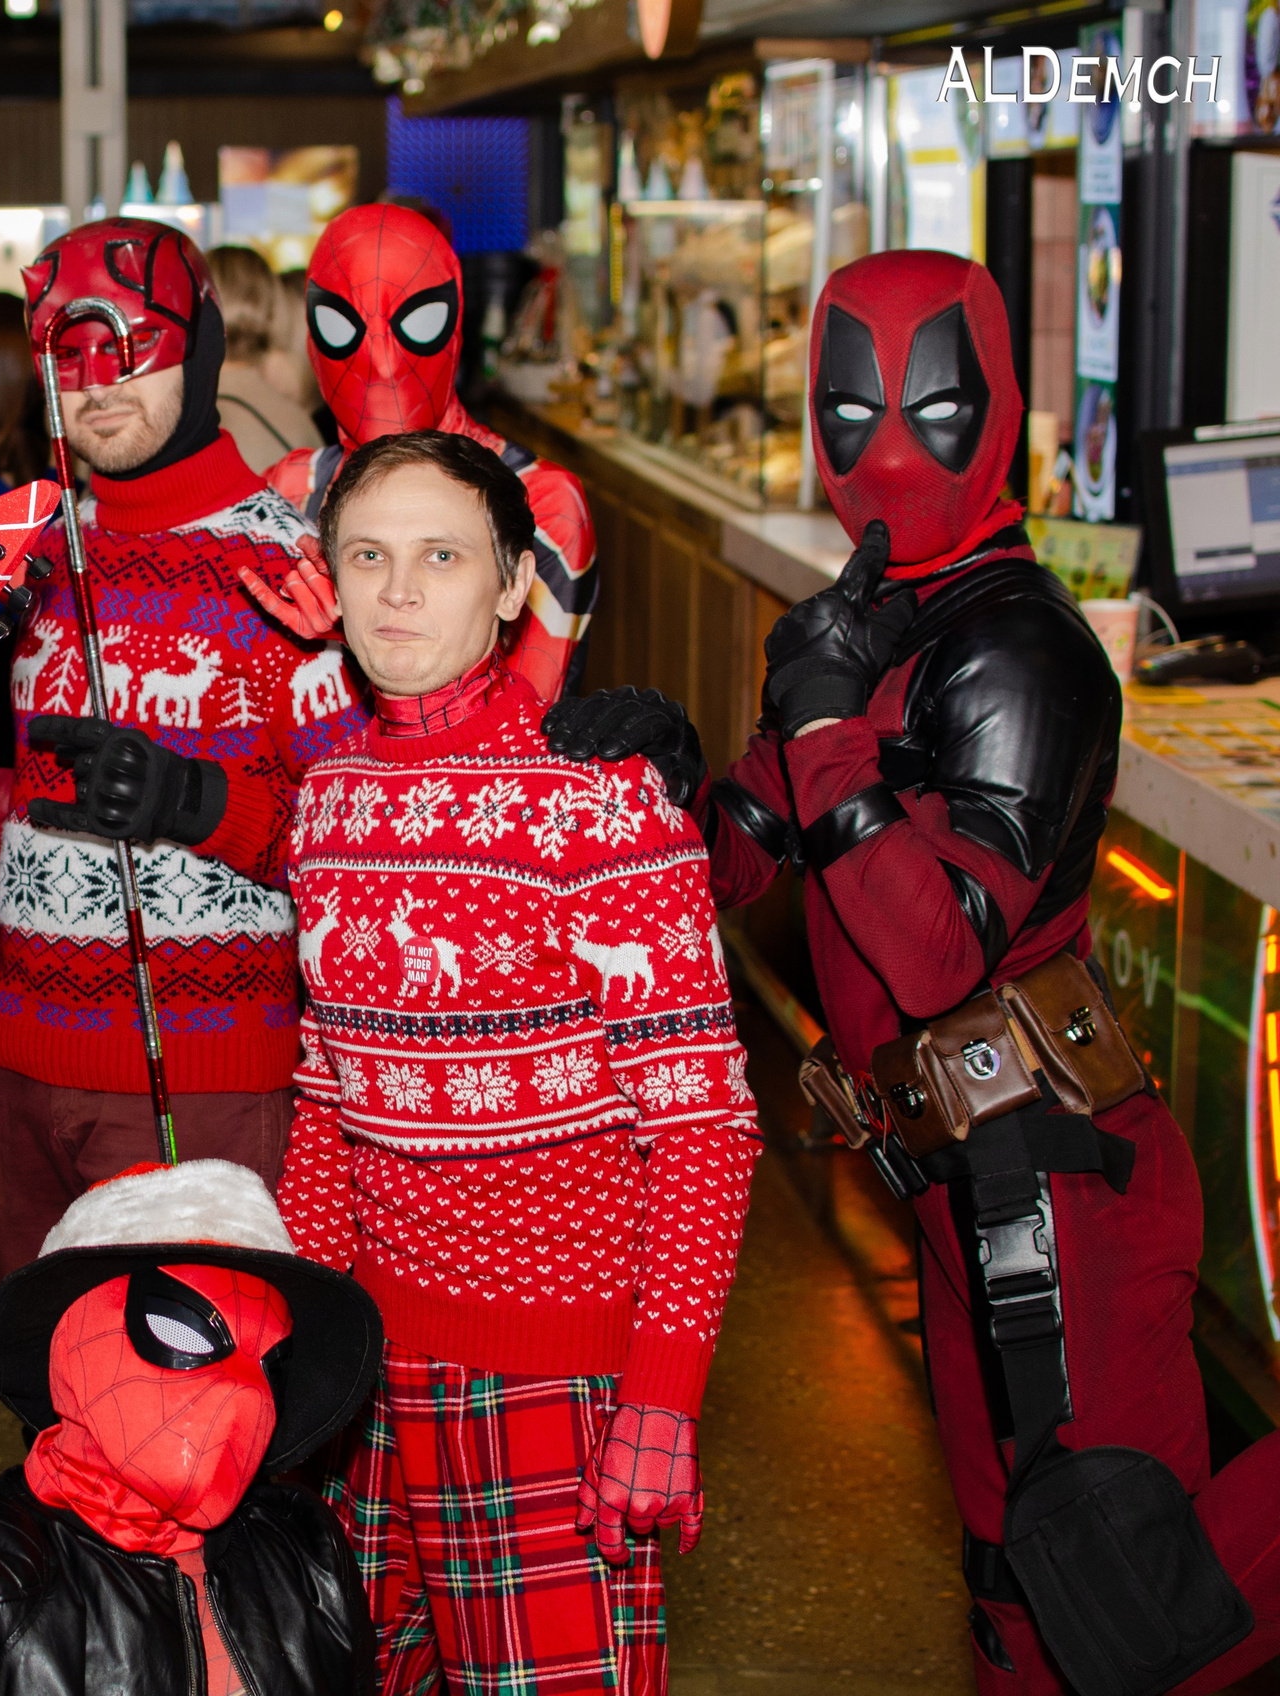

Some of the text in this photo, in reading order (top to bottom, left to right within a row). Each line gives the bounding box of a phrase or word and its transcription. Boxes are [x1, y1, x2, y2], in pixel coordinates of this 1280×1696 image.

[404, 944, 433, 958] I'M NOT
[404, 956, 431, 971] SPIDER
[407, 970, 427, 983] MAN
